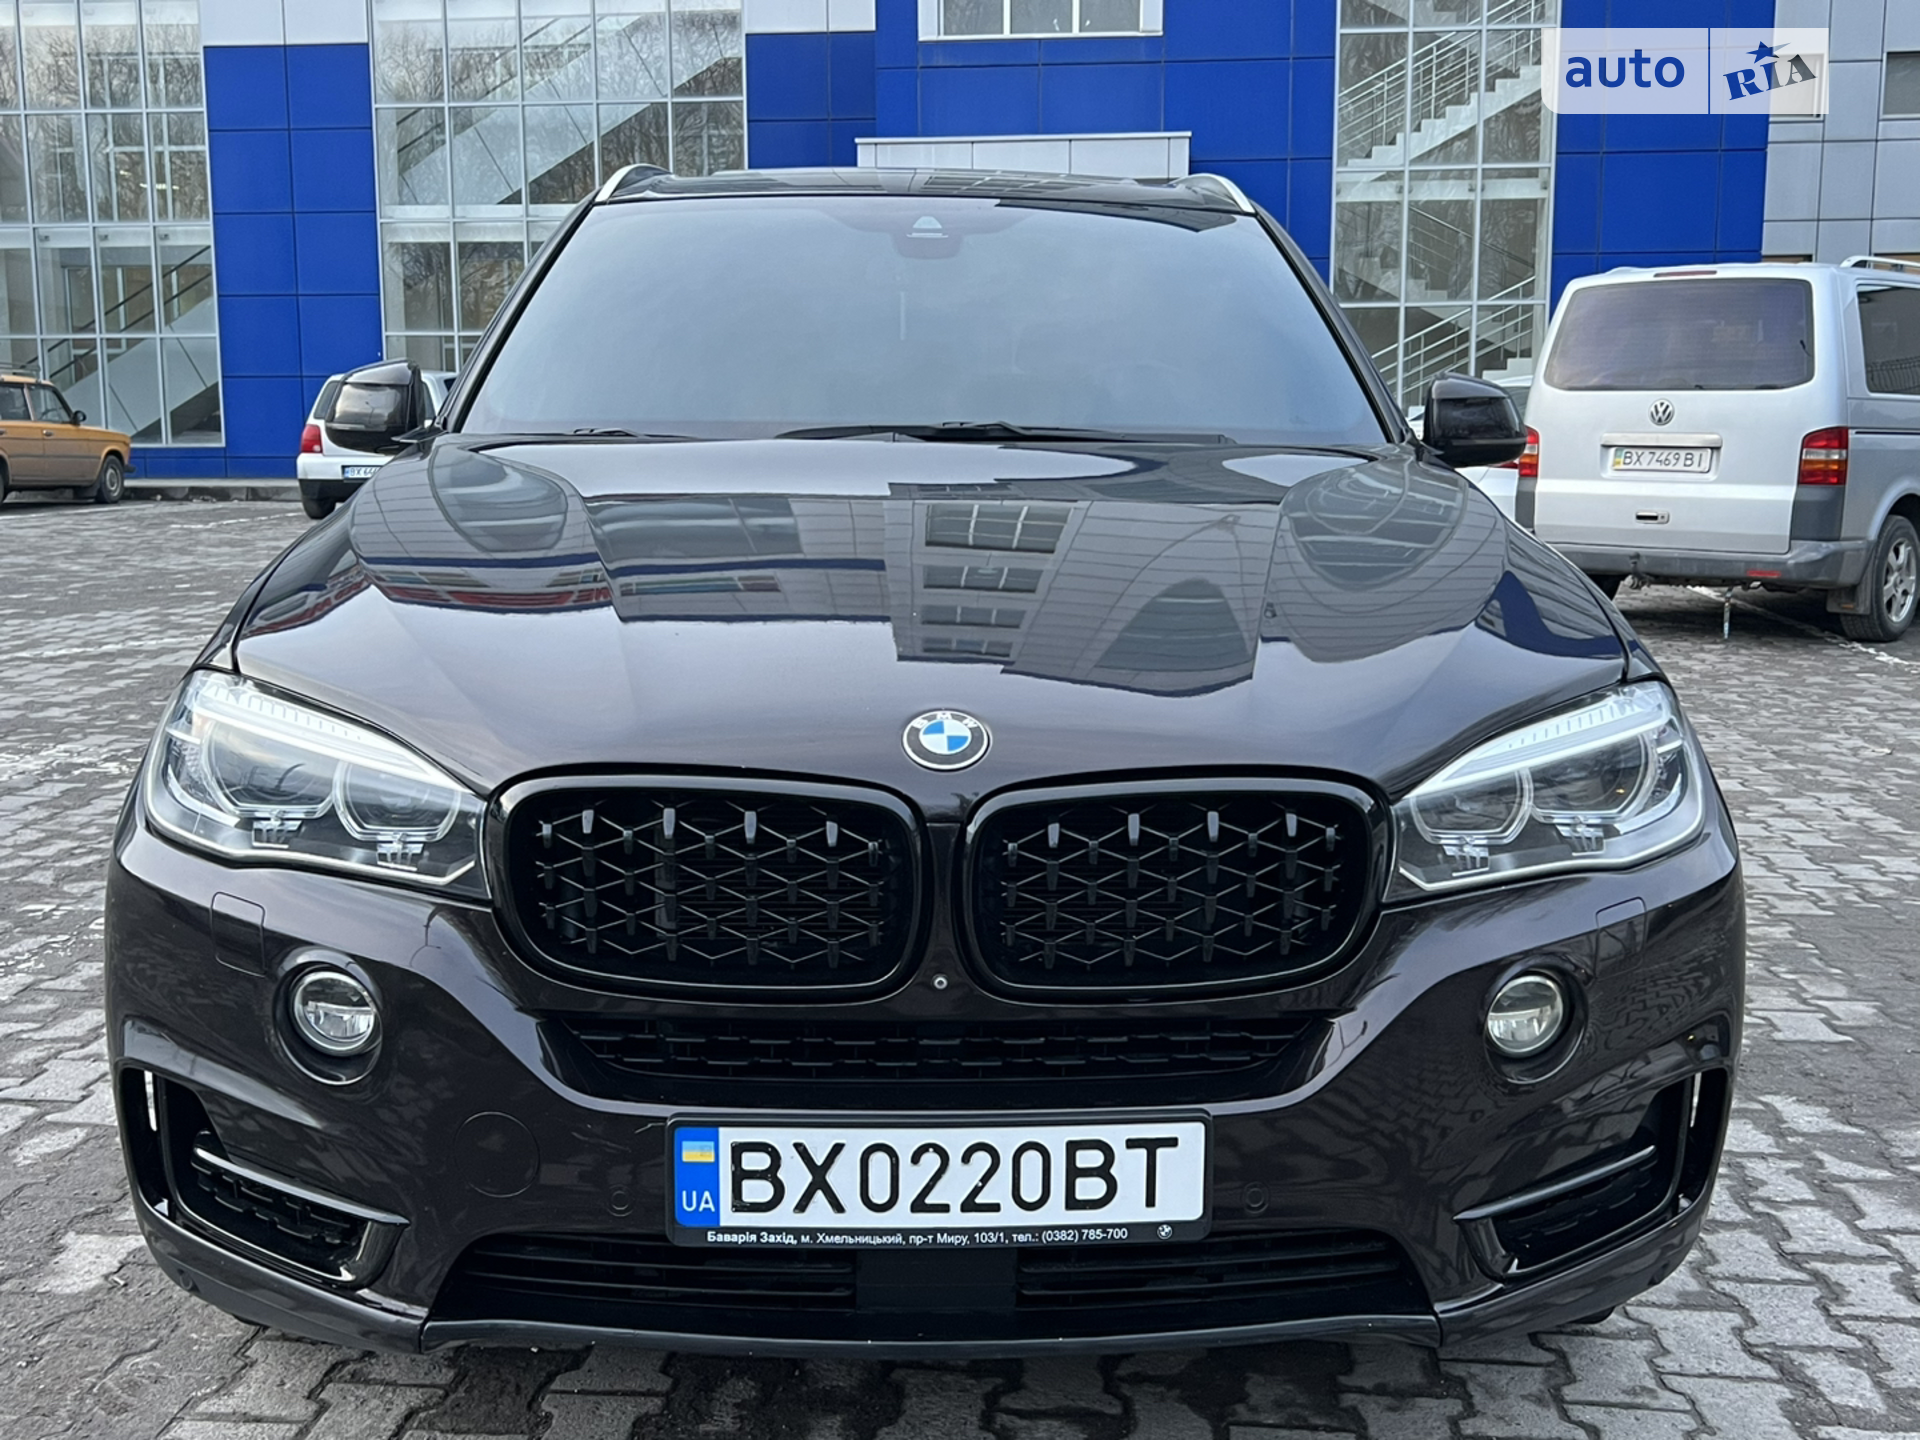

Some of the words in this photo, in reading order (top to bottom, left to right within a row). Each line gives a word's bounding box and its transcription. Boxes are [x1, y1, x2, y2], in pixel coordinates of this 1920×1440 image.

[730, 1137, 1179, 1214] BX0220BT
[681, 1190, 716, 1213] UA
[707, 1231, 757, 1244] Баварія
[760, 1232, 798, 1245] Захід,
[801, 1234, 813, 1244] м.
[816, 1233, 906, 1246] Хмельницький,
[909, 1234, 934, 1246] пр-т
[937, 1233, 970, 1246] Миру,
[974, 1232, 1009, 1245] 103/1,
[1042, 1229, 1079, 1243] (0382)
[1081, 1228, 1128, 1241] 785-700
